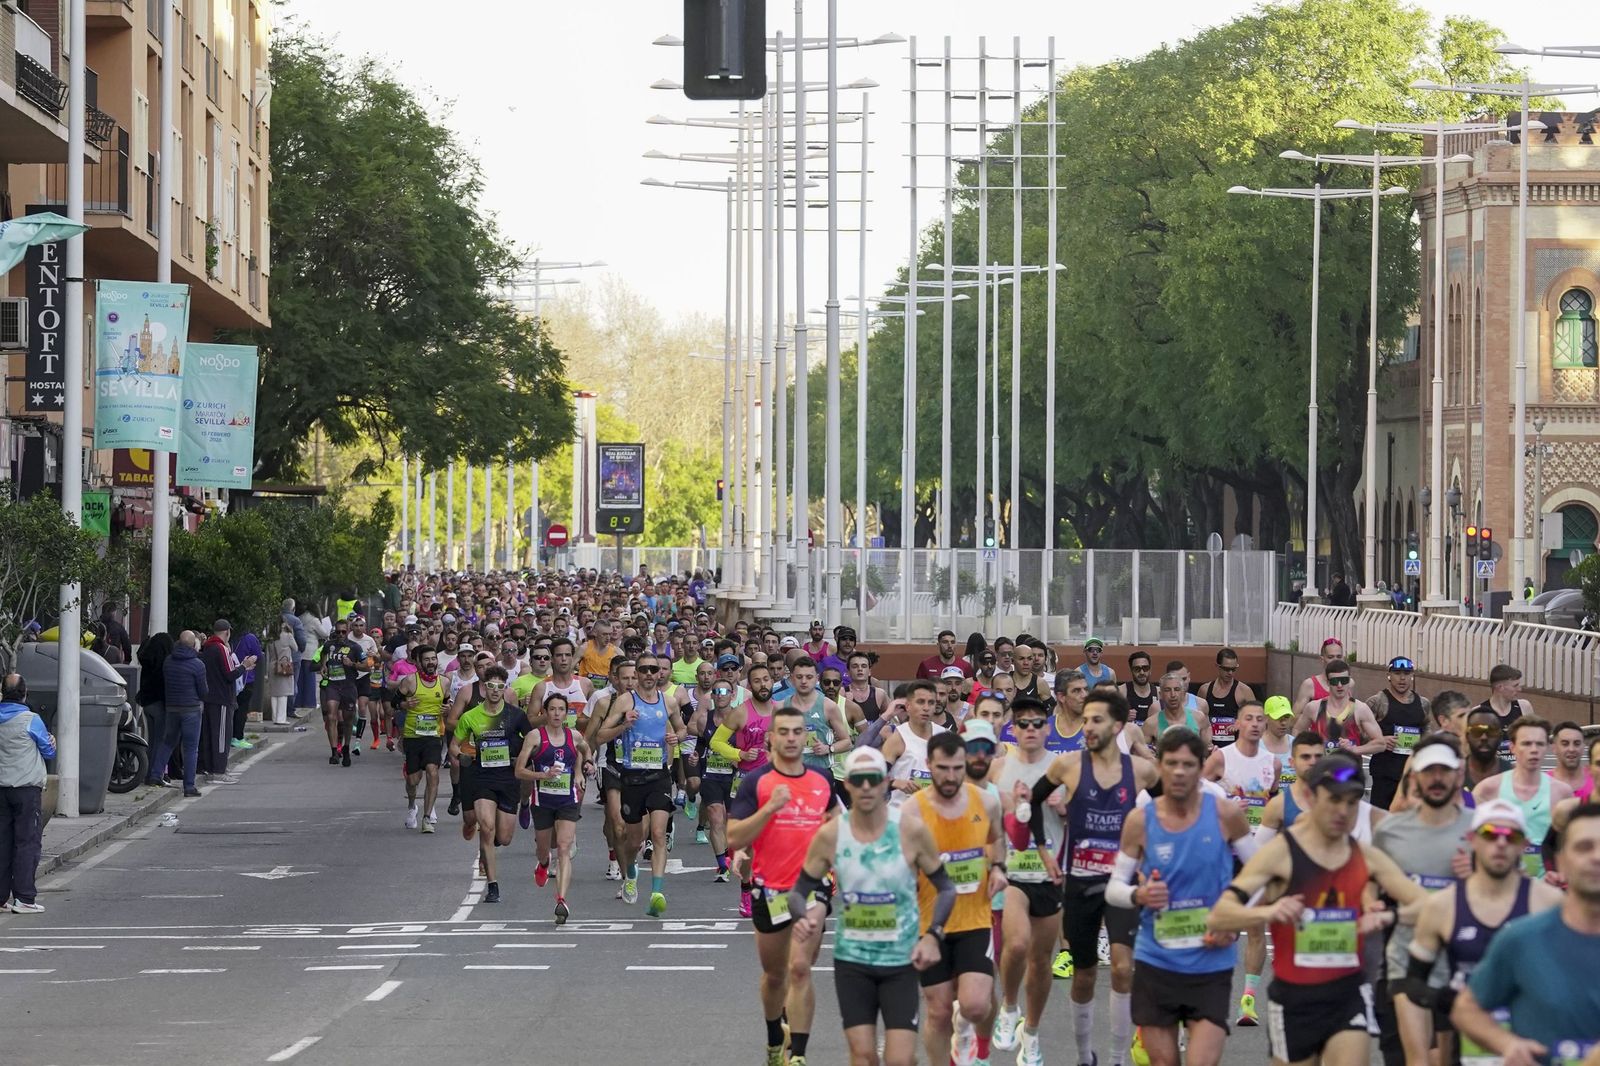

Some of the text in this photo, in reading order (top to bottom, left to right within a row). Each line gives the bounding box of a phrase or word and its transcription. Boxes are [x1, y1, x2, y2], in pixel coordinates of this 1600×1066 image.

[100, 378, 177, 401] SEVILLA
[196, 401, 226, 410] ZURICH
[194, 417, 226, 426] SEVILLA
[119, 472, 173, 485] TABACS
[82, 502, 104, 511] OCK
[1086, 813, 1122, 824] STADE
[953, 849, 979, 861] ZURICH
[1018, 862, 1042, 870] MARK
